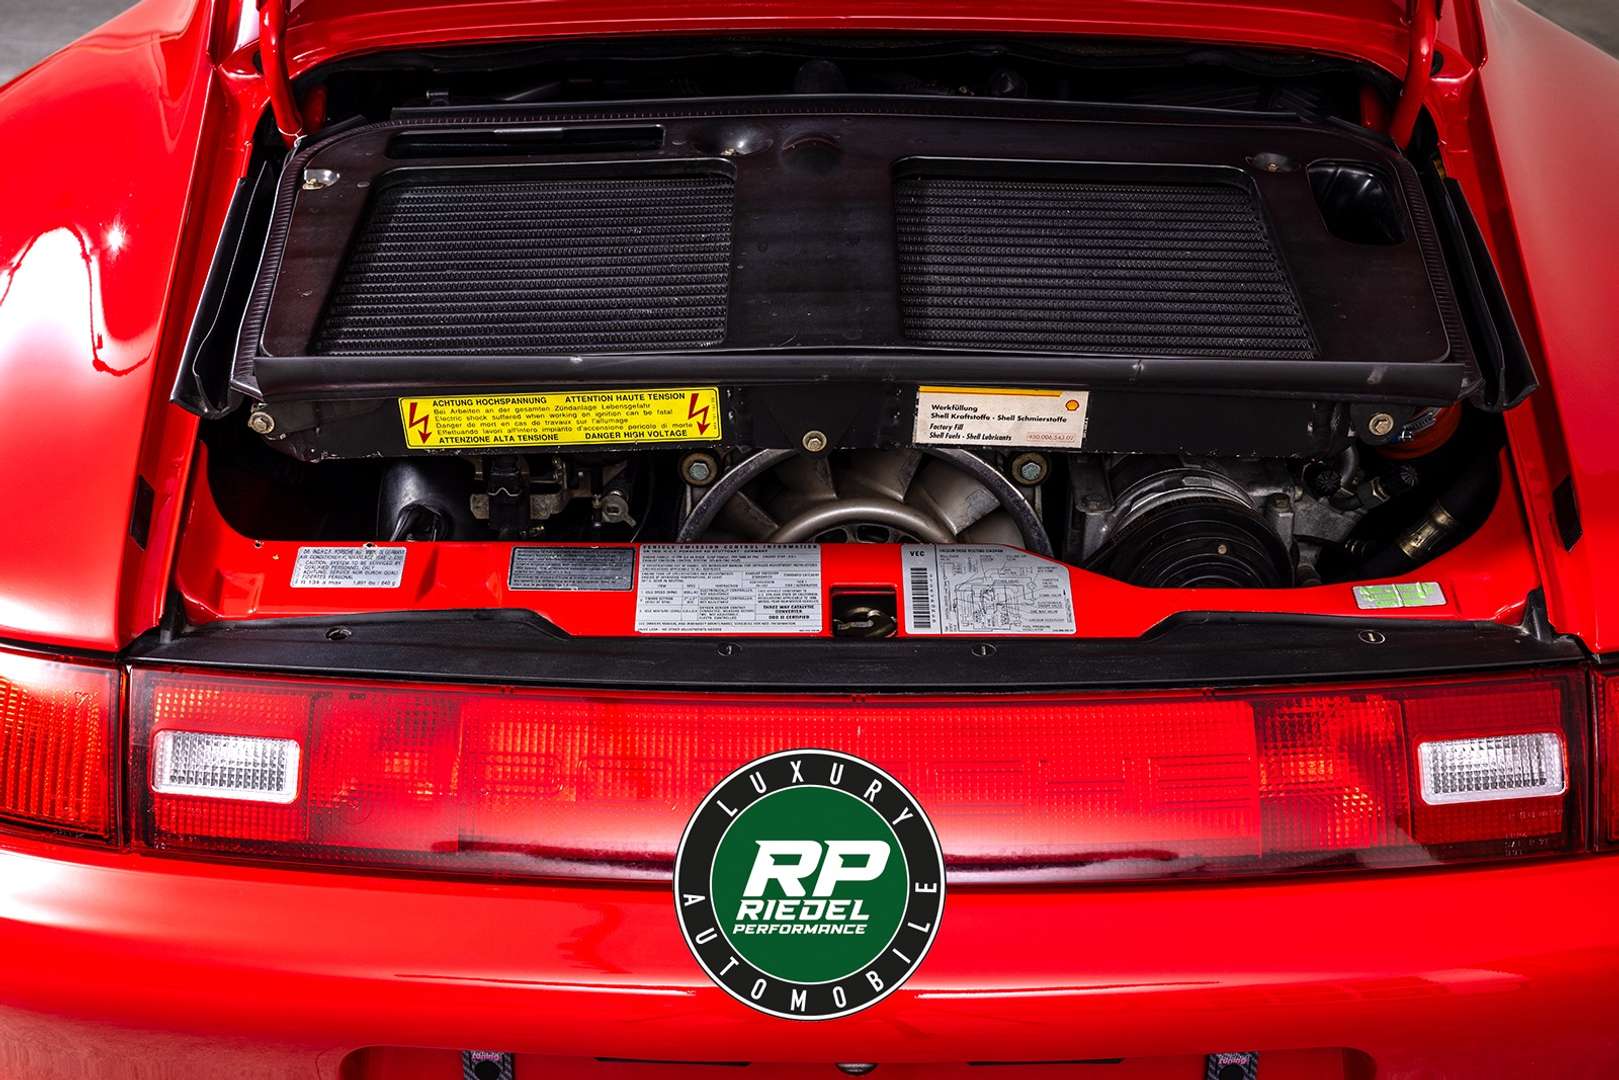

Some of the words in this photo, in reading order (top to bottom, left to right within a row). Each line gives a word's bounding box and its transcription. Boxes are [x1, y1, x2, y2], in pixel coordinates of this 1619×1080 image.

[433, 399, 473, 407] ACHTUNG
[476, 397, 547, 406] HOCHSPANNUNG
[565, 395, 613, 403] ATTENTION
[515, 406, 550, 414] gesamten
[931, 404, 978, 413] Werkfüllung
[550, 411, 577, 419] working
[950, 413, 991, 421] Kraftstoffe
[1017, 415, 1067, 423] Schmierstoffe
[628, 423, 657, 431] pericolo
[929, 423, 953, 432] Factory
[439, 436, 490, 444] ATTENZIONE
[517, 433, 559, 442] TENSIONE
[585, 431, 621, 440] DANGER
[647, 429, 688, 438] VOLTAGE
